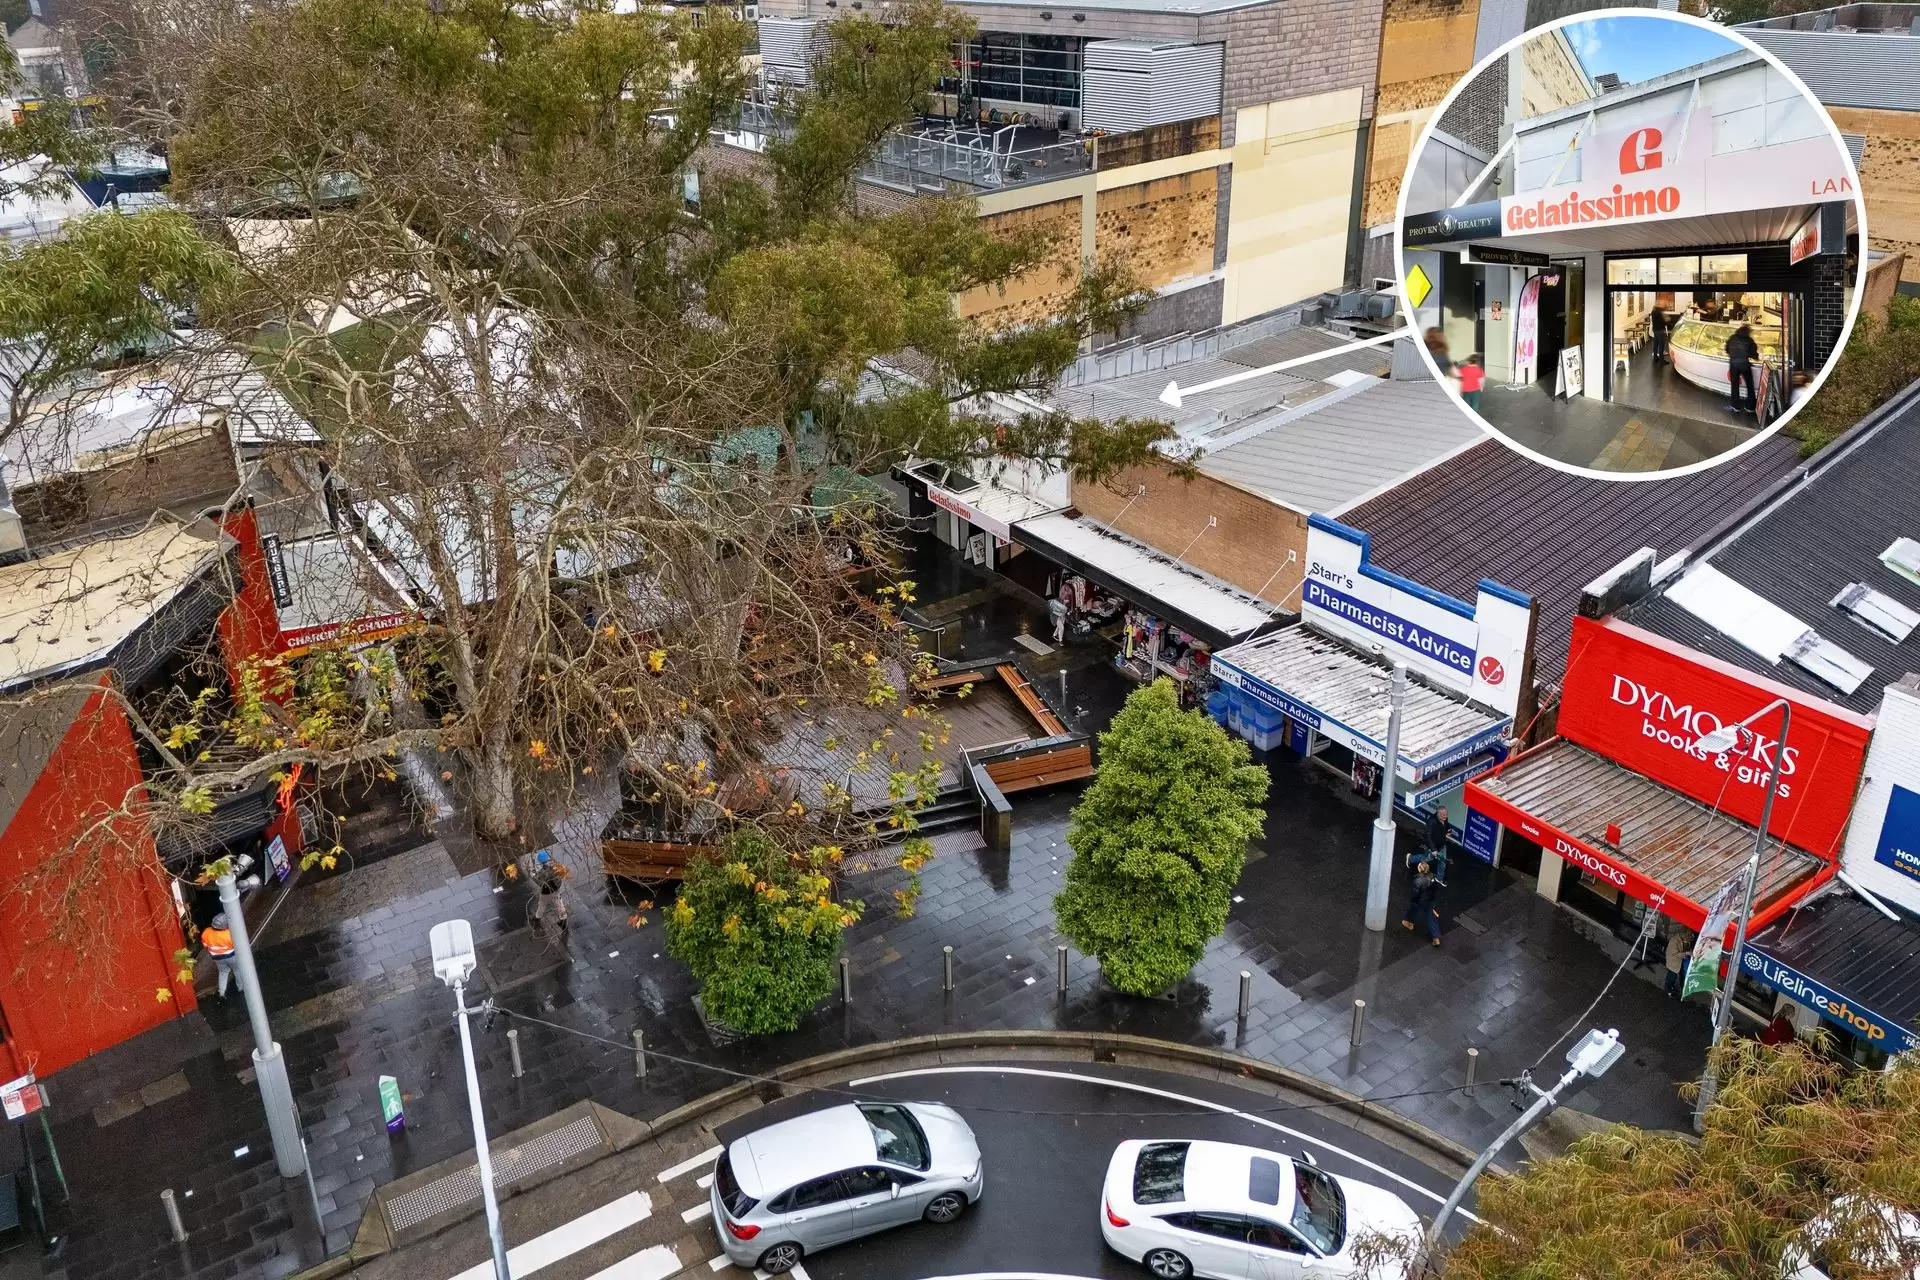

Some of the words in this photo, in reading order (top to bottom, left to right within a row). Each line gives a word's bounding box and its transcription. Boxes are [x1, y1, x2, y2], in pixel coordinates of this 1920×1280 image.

[1619, 127, 1662, 175] G
[1507, 184, 1681, 231] Gelatissimo
[1409, 225, 1438, 236] PROVEN
[1458, 217, 1493, 229] BEAUTY
[929, 489, 971, 520] Gelatissimo
[1312, 562, 1353, 589] Starr's
[1309, 584, 1405, 640] Pharmacist
[1406, 627, 1471, 669] Advice
[1213, 664, 1240, 684] Starr's
[1241, 679, 1288, 710] Pharmacist
[1289, 705, 1320, 727] Advice
[1350, 738, 1372, 755] Open
[1374, 750, 1379, 759] 7
[1424, 748, 1473, 776] Pharmacist
[1641, 719, 1708, 761] books
[1714, 753, 1730, 772] &
[1737, 764, 1791, 798] gifs
[1419, 776, 1461, 802] Pharmacist
[1463, 764, 1488, 782] Advice
[1521, 822, 1540, 837] books
[1556, 838, 1627, 885] DYMOCKS
[1650, 893, 1665, 905] gifts
